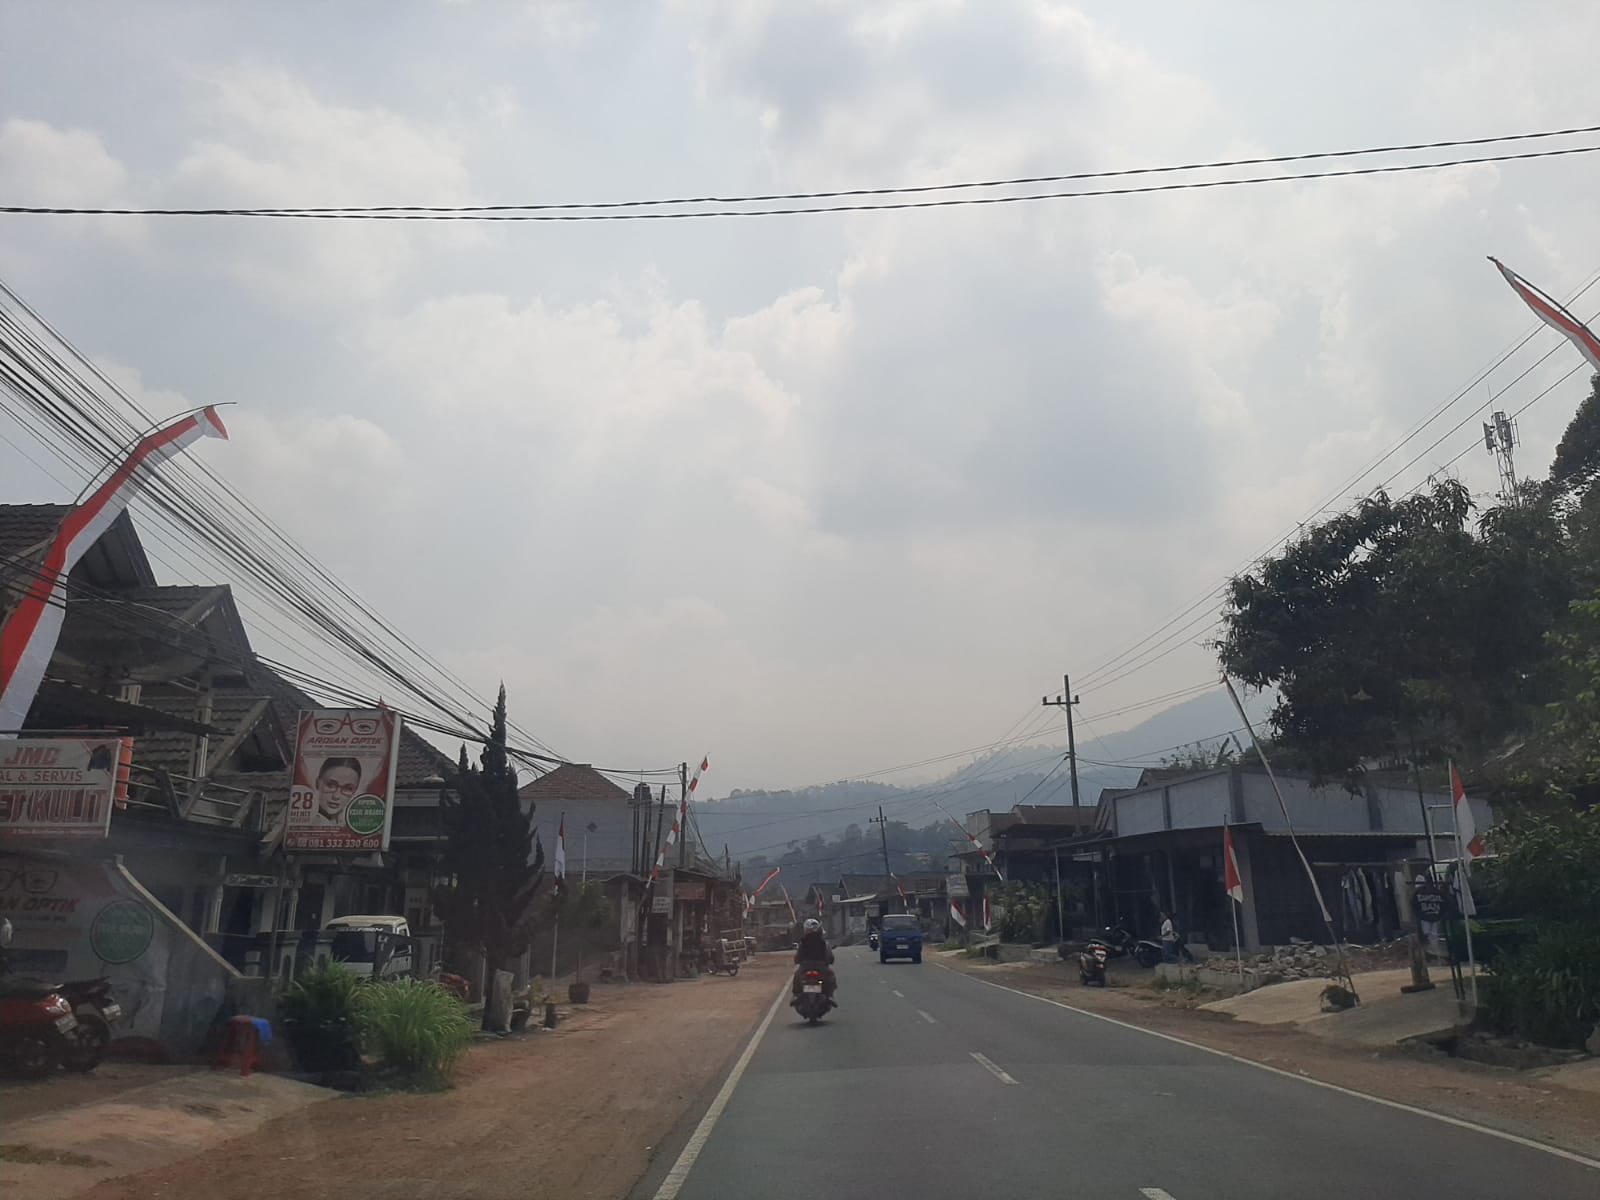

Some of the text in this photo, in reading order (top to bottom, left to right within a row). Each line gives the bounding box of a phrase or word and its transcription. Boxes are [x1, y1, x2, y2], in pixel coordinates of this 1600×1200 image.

[350, 736, 383, 745] OPTIK
[4, 747, 61, 765] JMC
[18, 770, 28, 781] &
[34, 769, 83, 781] SERVIS
[28, 789, 107, 822] KULIT
[291, 792, 313, 810] 28
[327, 839, 343, 848] 332
[345, 839, 361, 848] 330
[363, 839, 380, 848] 600
